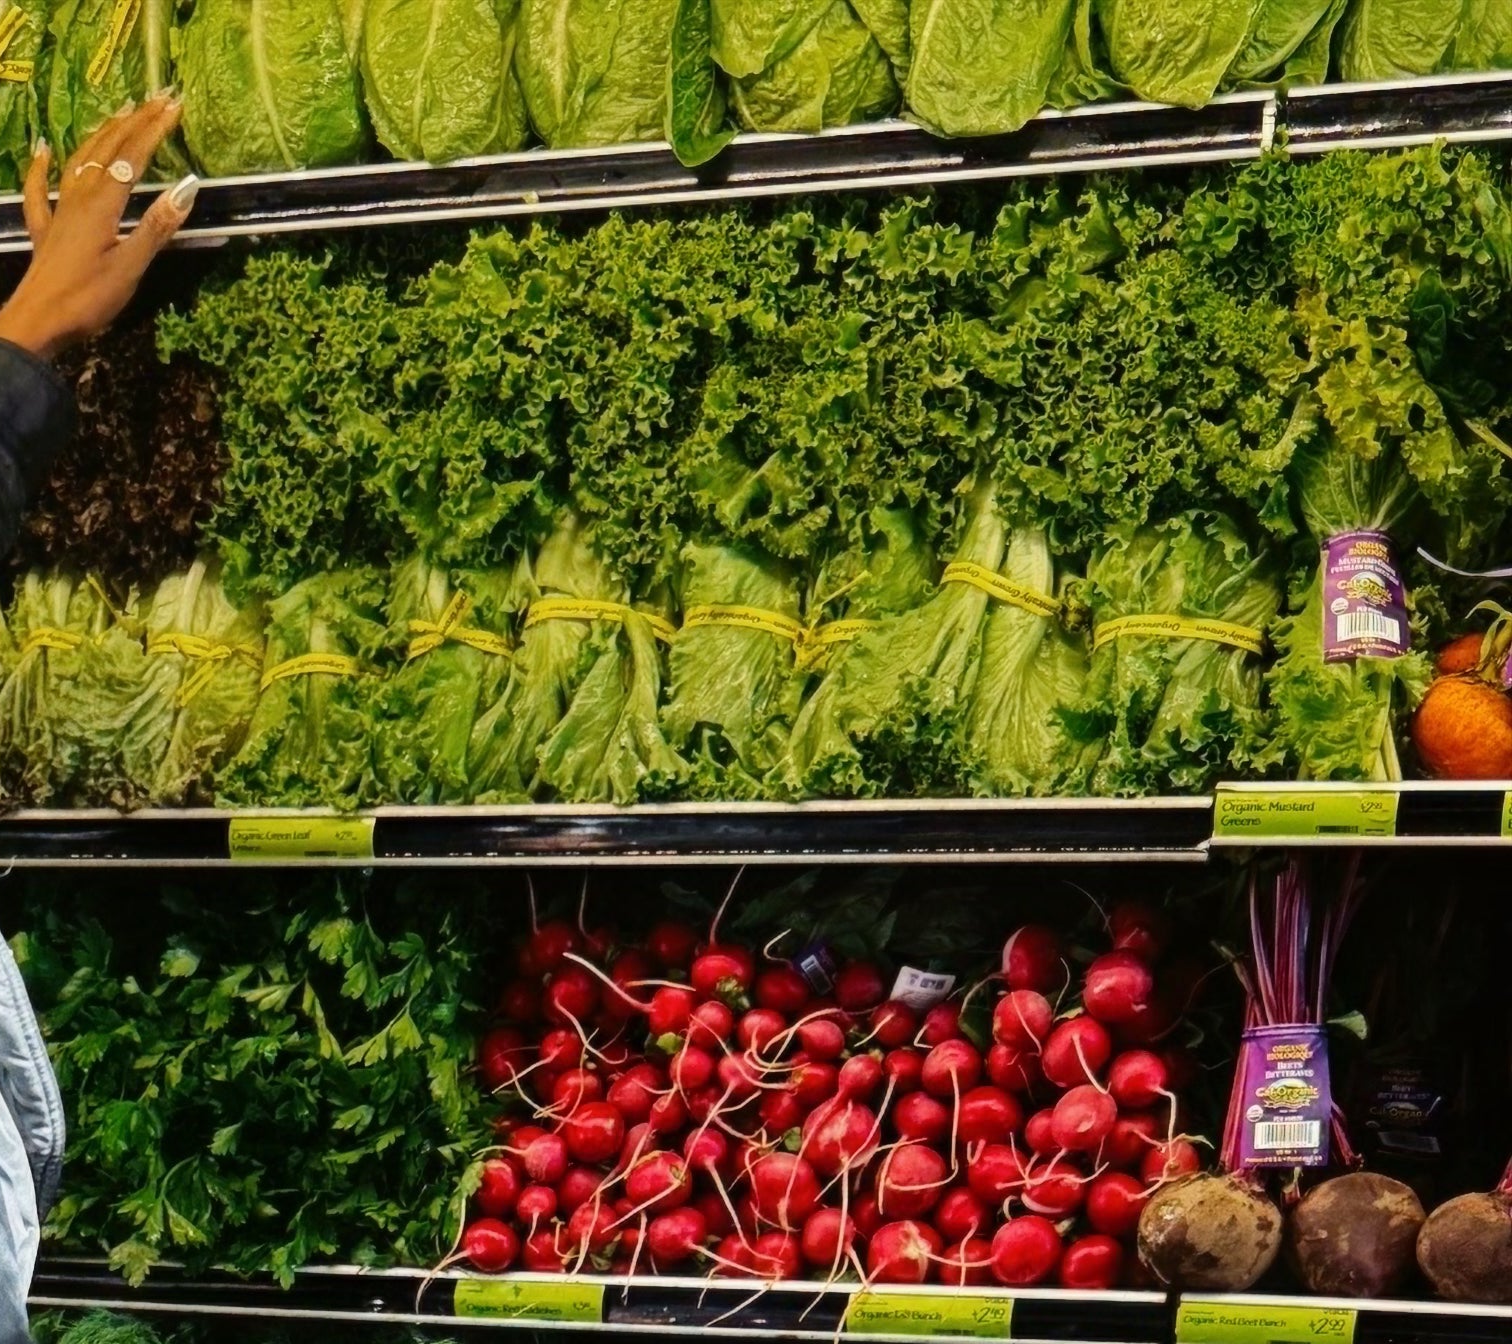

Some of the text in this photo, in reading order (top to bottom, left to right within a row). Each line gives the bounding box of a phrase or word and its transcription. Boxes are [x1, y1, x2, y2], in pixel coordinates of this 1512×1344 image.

[1221, 801, 1267, 816] Organic
[1268, 801, 1316, 813] Mustard
[1220, 815, 1262, 827] Greens
[231, 830, 264, 843] Organic
[853, 1308, 894, 1321] Organic
[911, 1310, 943, 1321] Bunch
[1183, 1315, 1217, 1328] Organic
[1219, 1316, 1238, 1326] Red
[1237, 1317, 1258, 1327] Beet
[1258, 1318, 1287, 1328] Bunch
